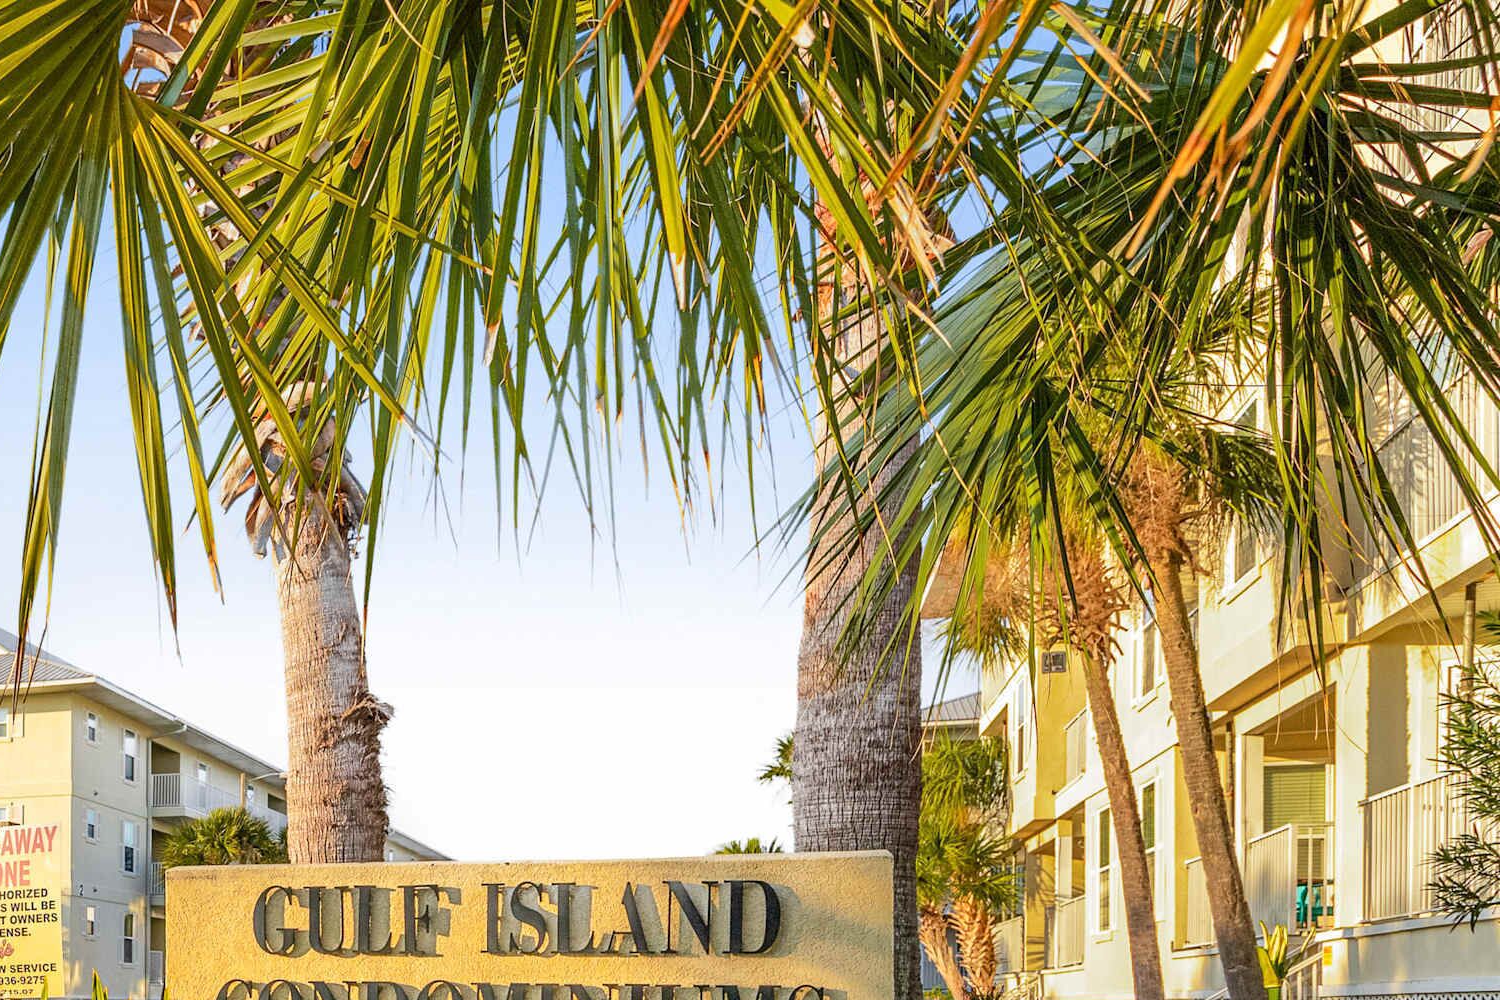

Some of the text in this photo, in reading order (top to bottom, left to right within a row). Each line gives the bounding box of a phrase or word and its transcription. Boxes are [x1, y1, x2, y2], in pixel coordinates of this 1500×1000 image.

[10, 901, 37, 912] WILL
[41, 900, 56, 911] BE
[10, 912, 58, 925] OWNERS
[253, 880, 782, 956] GULF ISLAND
[10, 963, 57, 973] SERVICE
